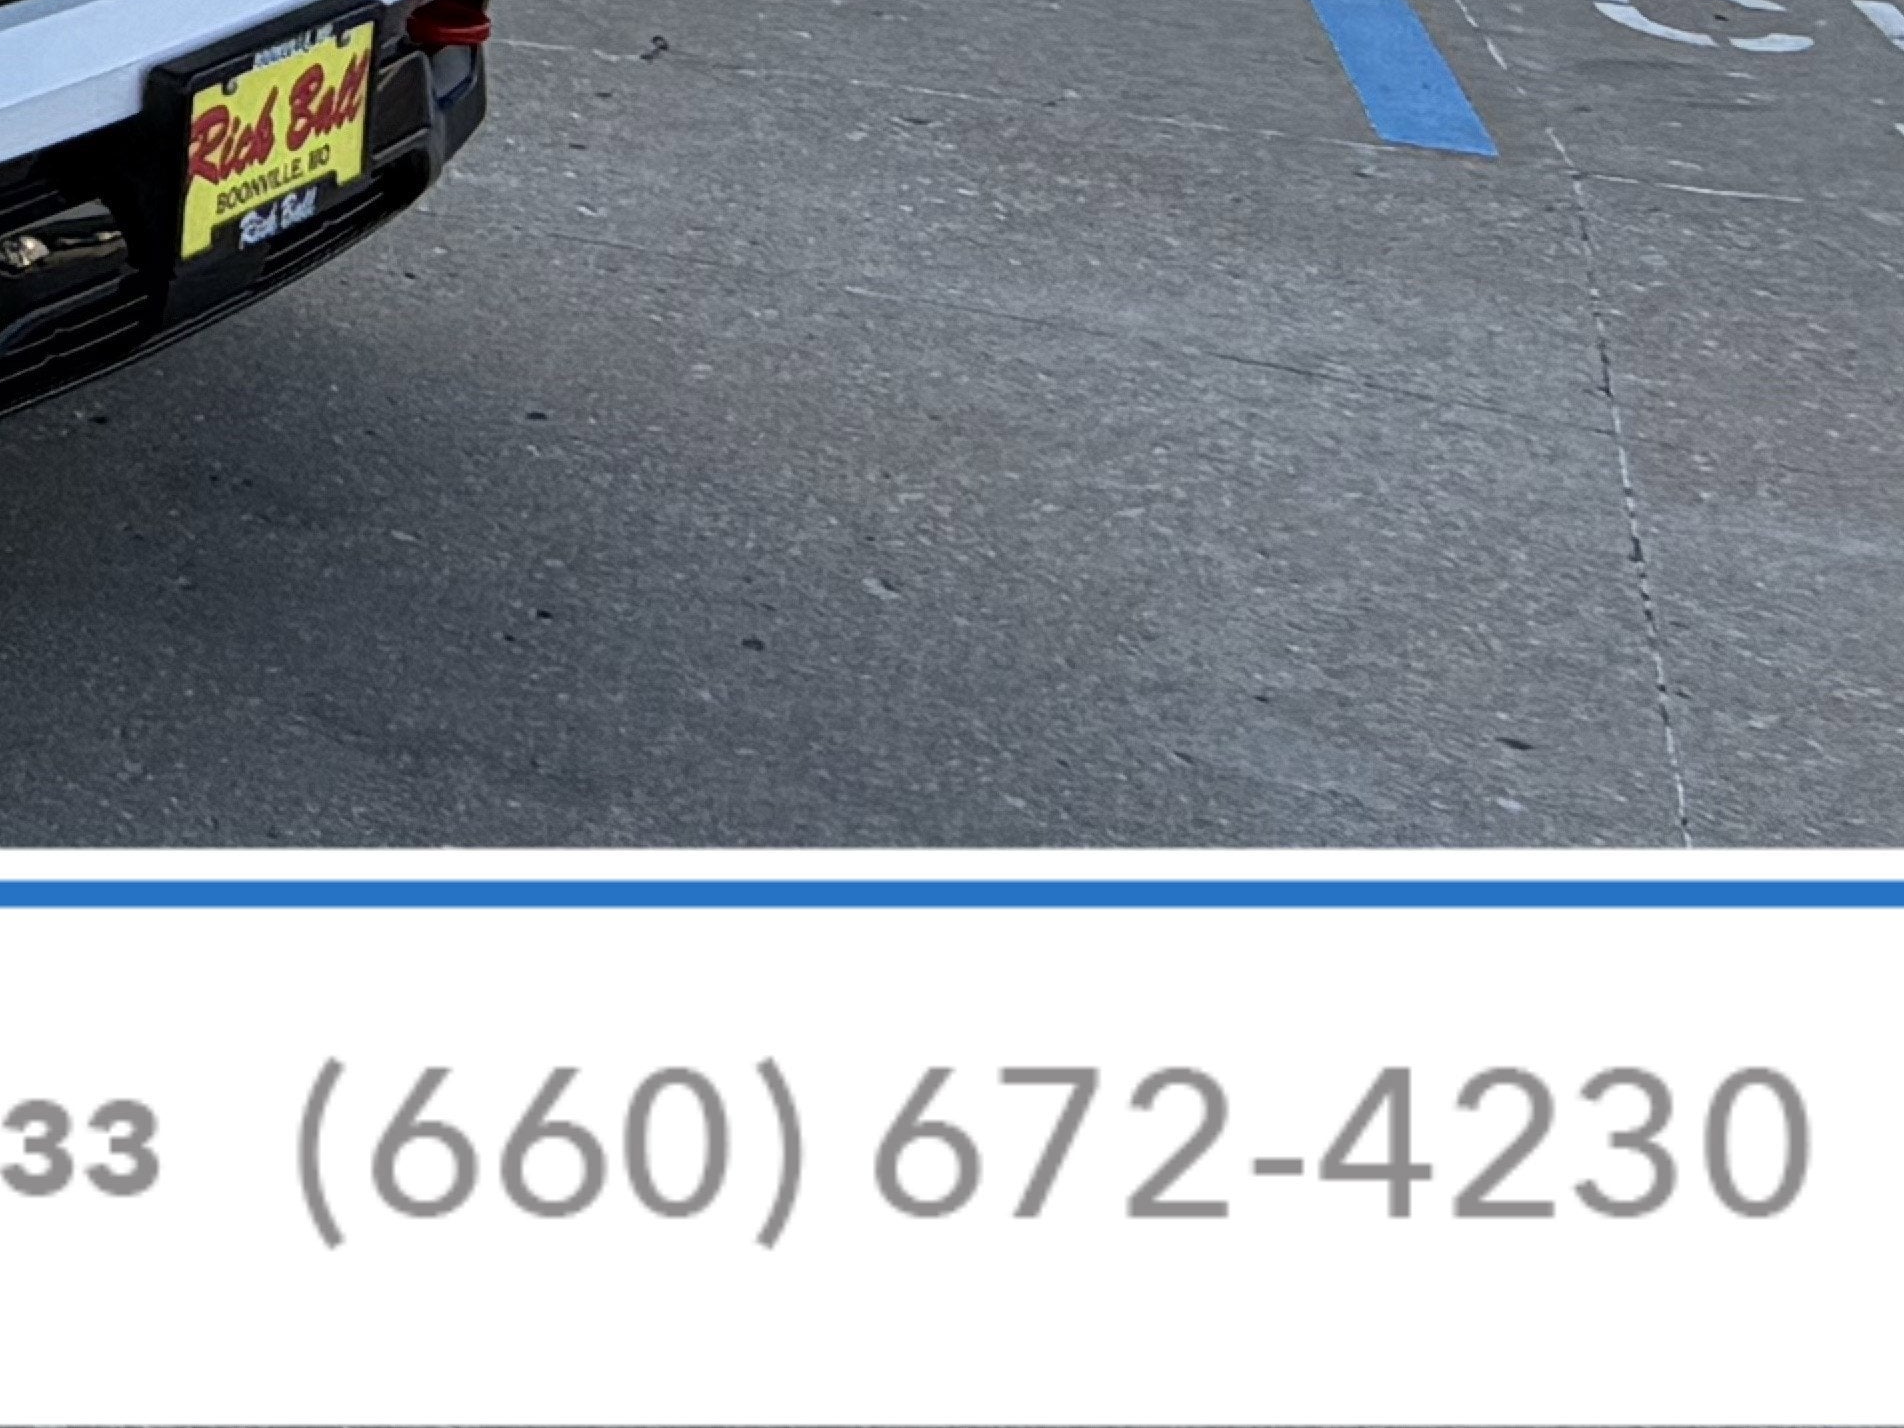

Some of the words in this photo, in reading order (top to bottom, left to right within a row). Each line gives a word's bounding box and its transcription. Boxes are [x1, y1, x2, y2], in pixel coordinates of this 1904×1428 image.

[188, 84, 279, 185] Rick
[286, 48, 370, 152] Ball
[215, 156, 303, 215] BOONVILLE
